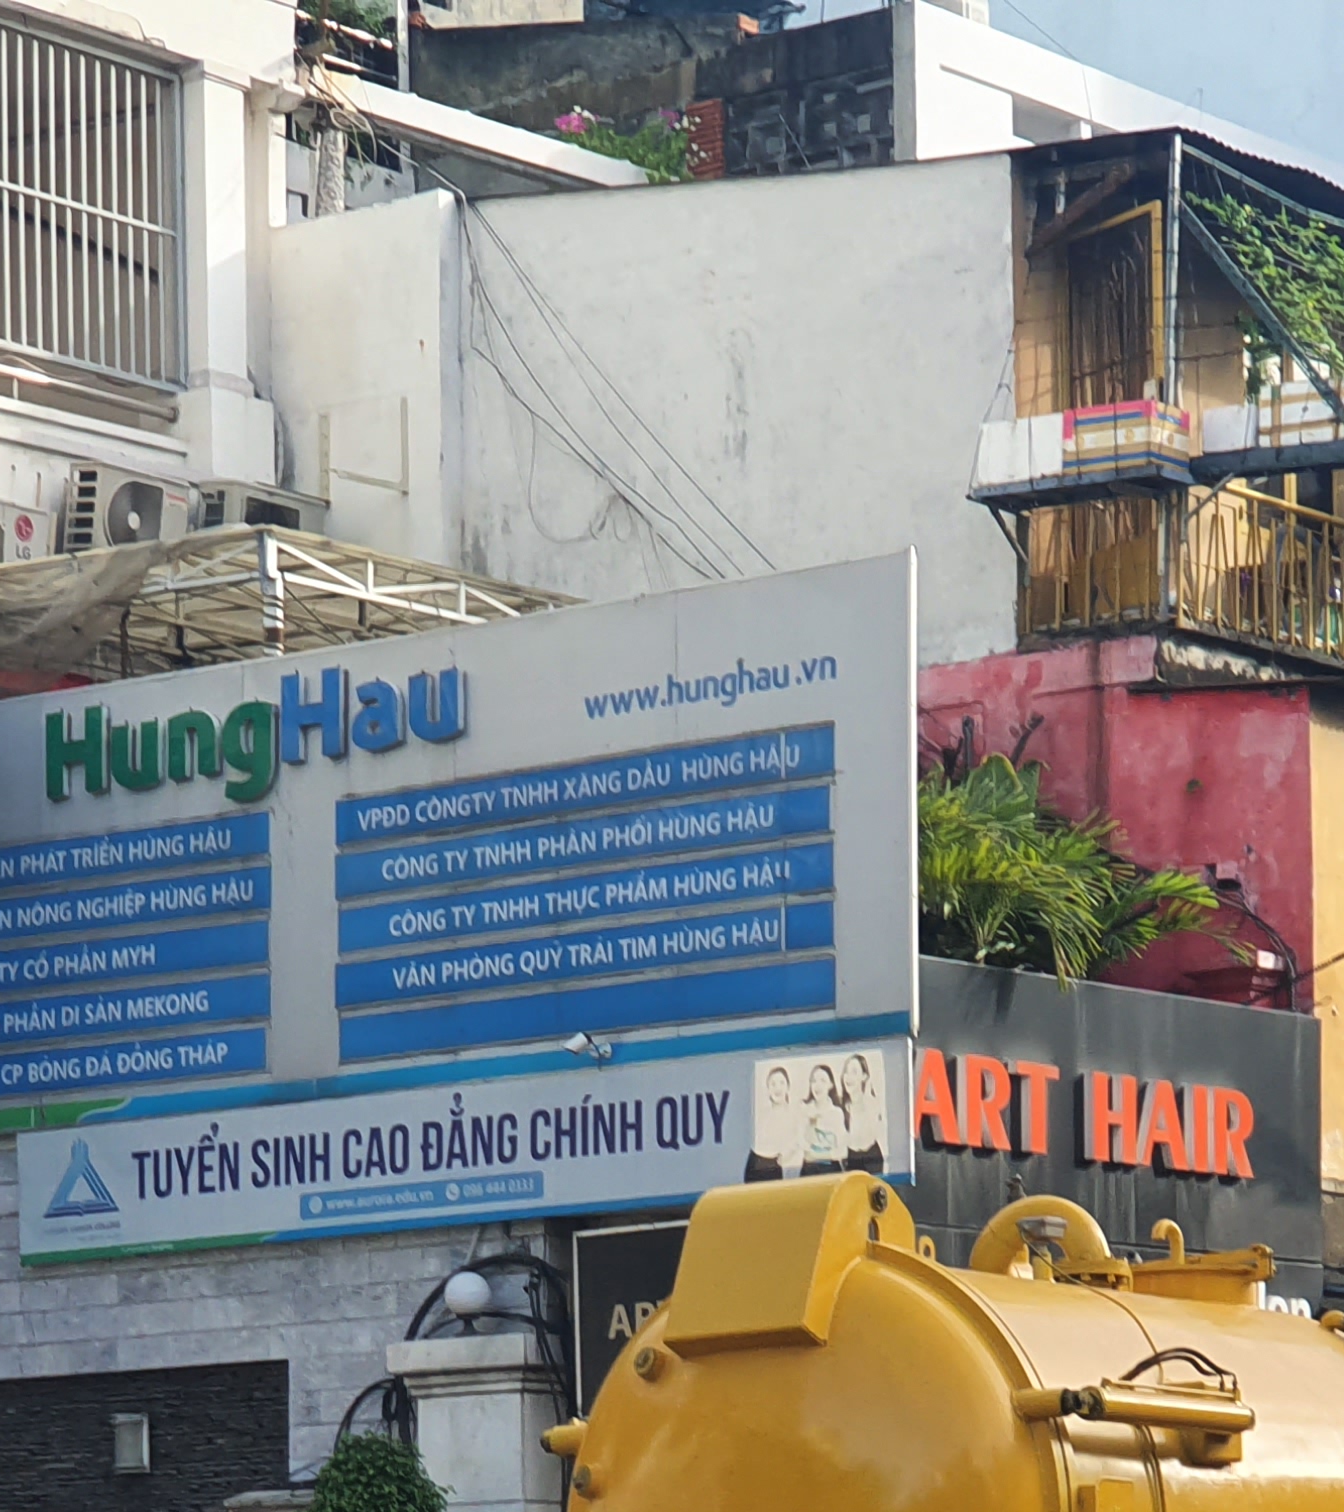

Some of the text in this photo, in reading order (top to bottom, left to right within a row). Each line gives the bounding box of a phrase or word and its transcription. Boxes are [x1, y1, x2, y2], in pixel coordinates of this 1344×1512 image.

[584, 655, 837, 720] www.hunghau.vn
[43, 661, 466, 802] HungHau
[500, 780, 558, 809] TNHH
[627, 758, 671, 791] DẦU
[681, 751, 744, 783] HÙNG
[129, 832, 184, 863] HÙNG
[189, 826, 231, 856] HẬU
[382, 852, 439, 882] CÔNG
[443, 849, 468, 873] TY
[473, 839, 531, 869] TNHH
[658, 810, 721, 843] HÙNG
[727, 801, 775, 835] HẬU
[17, 902, 72, 928] NÔNG
[77, 887, 146, 921] NGHIỆP
[150, 883, 206, 913] HÙNG
[212, 875, 254, 906] HẬU
[389, 909, 446, 938] CÔNG
[451, 904, 476, 928] TY
[480, 895, 540, 925] TNHH
[674, 866, 737, 898] HÙNG
[111, 943, 156, 970] MYH
[441, 951, 514, 985] PHÒNG
[618, 935, 656, 962] TIM
[663, 923, 726, 956] HÙNG
[731, 917, 779, 947] HẬU
[61, 1005, 80, 1028] DI
[126, 990, 209, 1021] MEKONG
[1, 1063, 23, 1086] CP
[131, 1089, 731, 1201] TUYỂN SINH CAO ĐẲNG CHÍNH QUY
[915, 1047, 1254, 1180] ART HAIR
